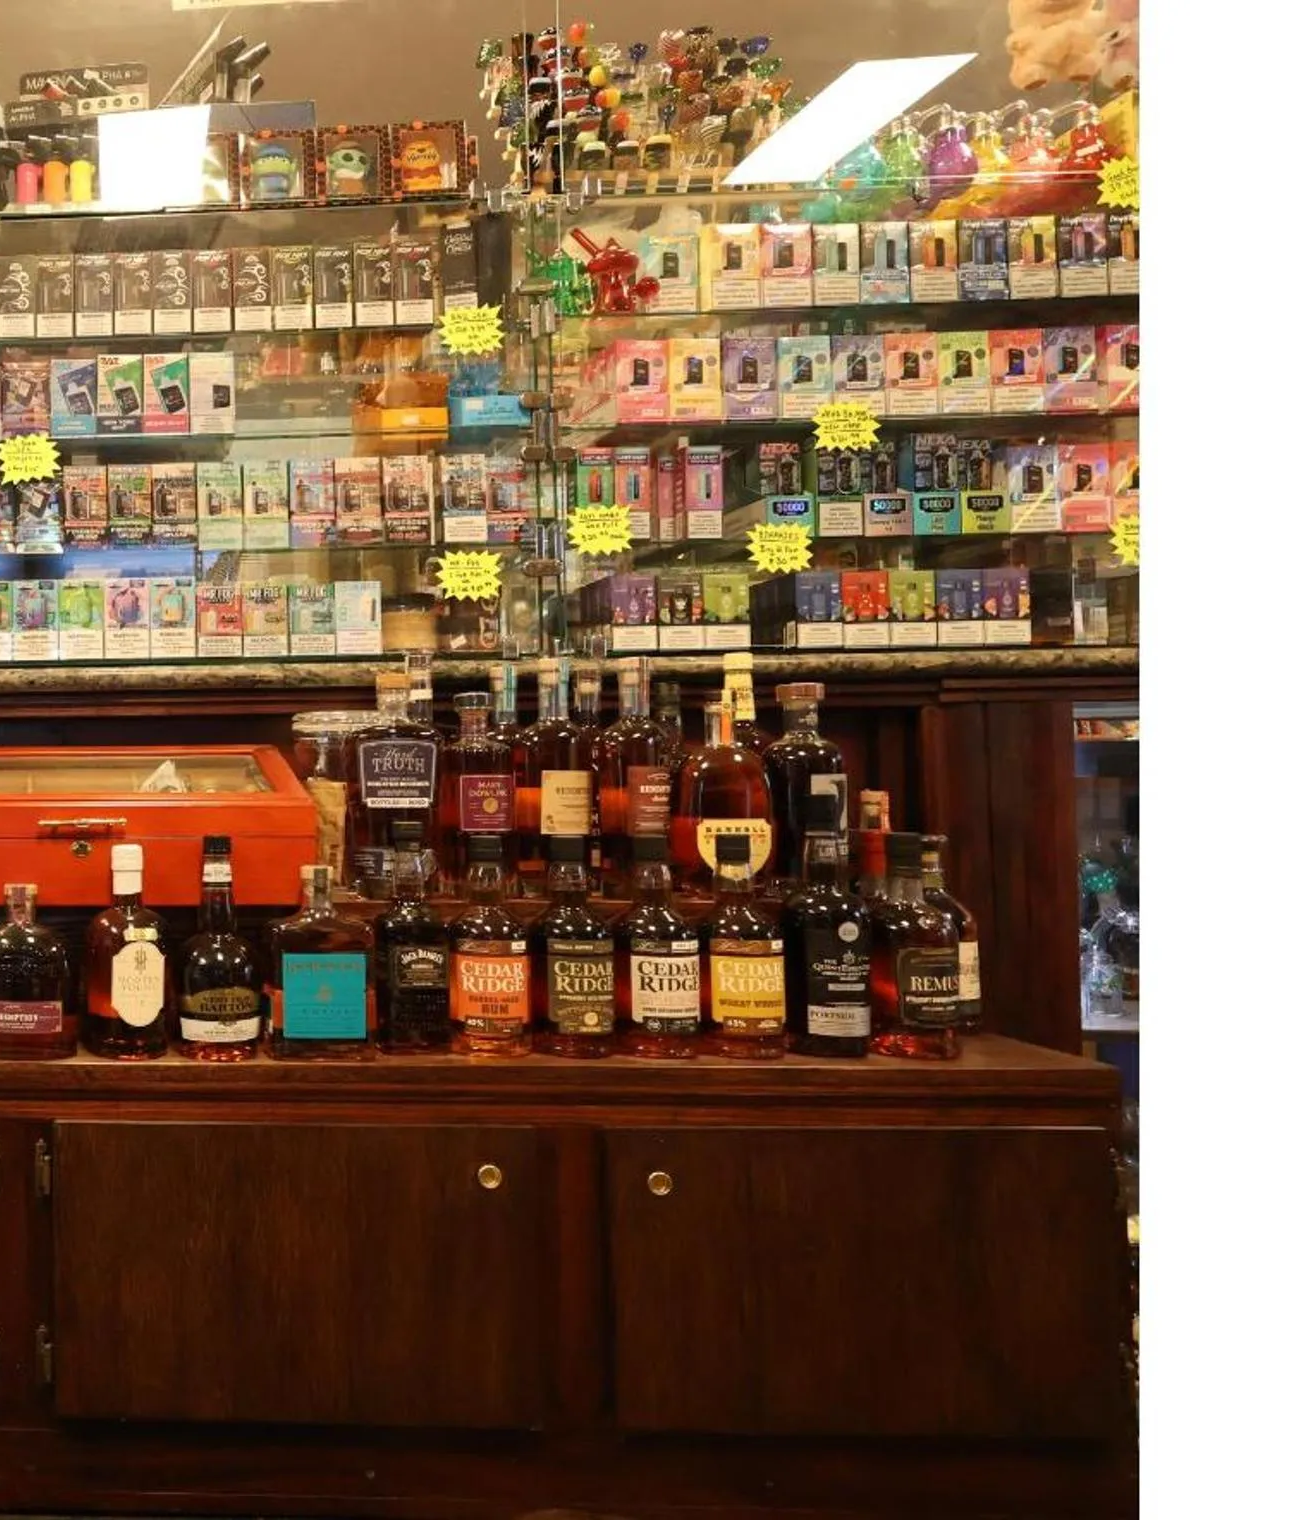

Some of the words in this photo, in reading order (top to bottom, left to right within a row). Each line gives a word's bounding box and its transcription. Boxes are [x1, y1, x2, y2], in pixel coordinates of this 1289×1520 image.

[371, 757, 425, 773] TRUTH
[460, 960, 524, 977] CEDAR
[553, 960, 613, 977] CEDAR
[636, 960, 698, 977] CEDAR
[717, 960, 783, 977] CEDAR
[461, 976, 526, 993] RIDGE
[555, 976, 614, 993] RIDGE
[637, 976, 700, 993] RIDGE
[717, 976, 784, 993] RIDGE
[909, 975, 960, 992] REMUS
[480, 1004, 510, 1015] RUM
